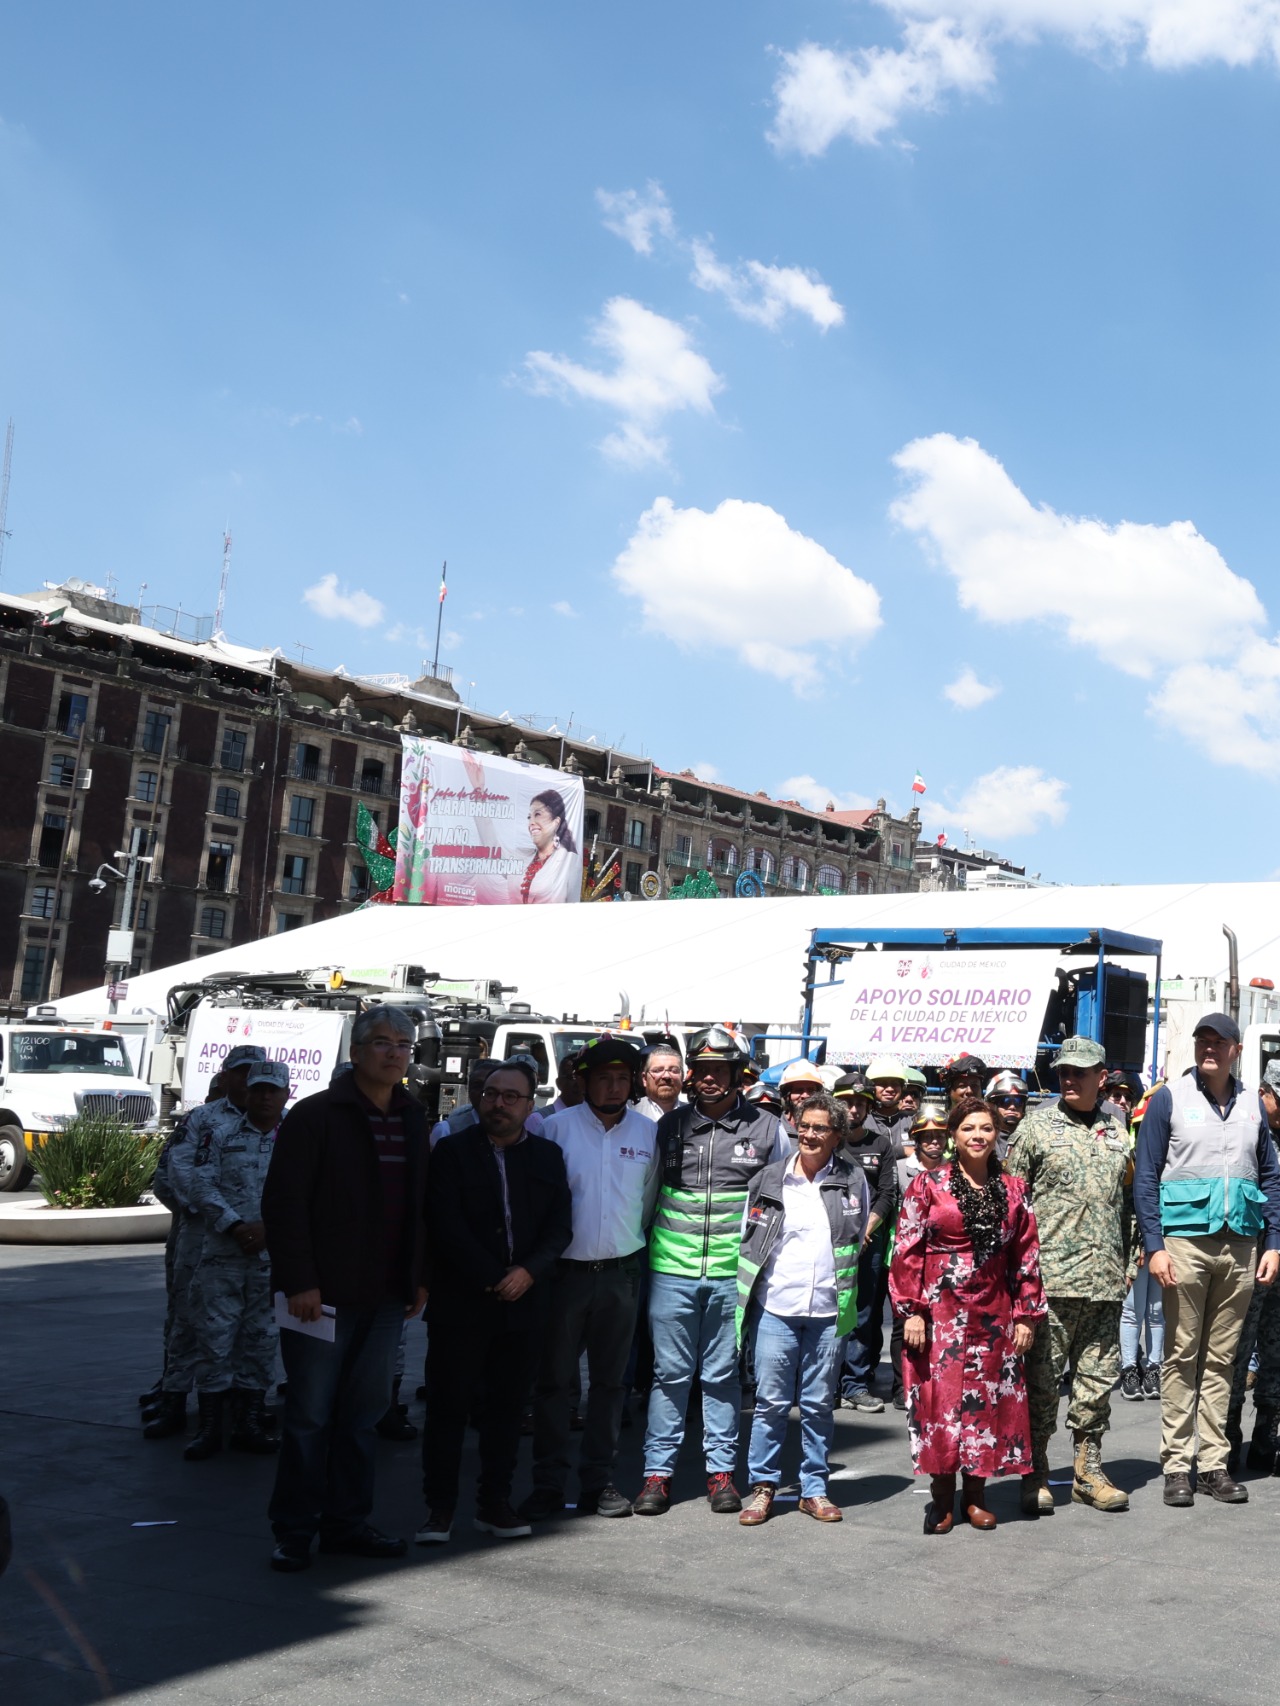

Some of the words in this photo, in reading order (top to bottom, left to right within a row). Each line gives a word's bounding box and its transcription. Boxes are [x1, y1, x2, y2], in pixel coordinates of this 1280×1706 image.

[430, 799, 467, 817] CLARA
[469, 801, 515, 819] BRUGADA
[445, 824, 470, 845] AÑO
[444, 884, 476, 897] morena
[940, 960, 966, 968] CIUDAD
[855, 988, 922, 1005] APOYO
[927, 988, 1031, 1006] SOLIDARIO
[850, 1009, 868, 1021] DE
[871, 1010, 888, 1021] LA
[893, 1010, 945, 1022] CIUDAD
[950, 1011, 968, 1022] DE
[971, 1008, 1028, 1023] MÉXICO
[869, 1026, 882, 1042] A
[891, 1027, 995, 1043] VERACRUZ
[200, 1043, 236, 1059] APO
[265, 1047, 322, 1065] LIDARIO
[198, 1062, 210, 1073] DE
[289, 1065, 320, 1081] ÉXICO
